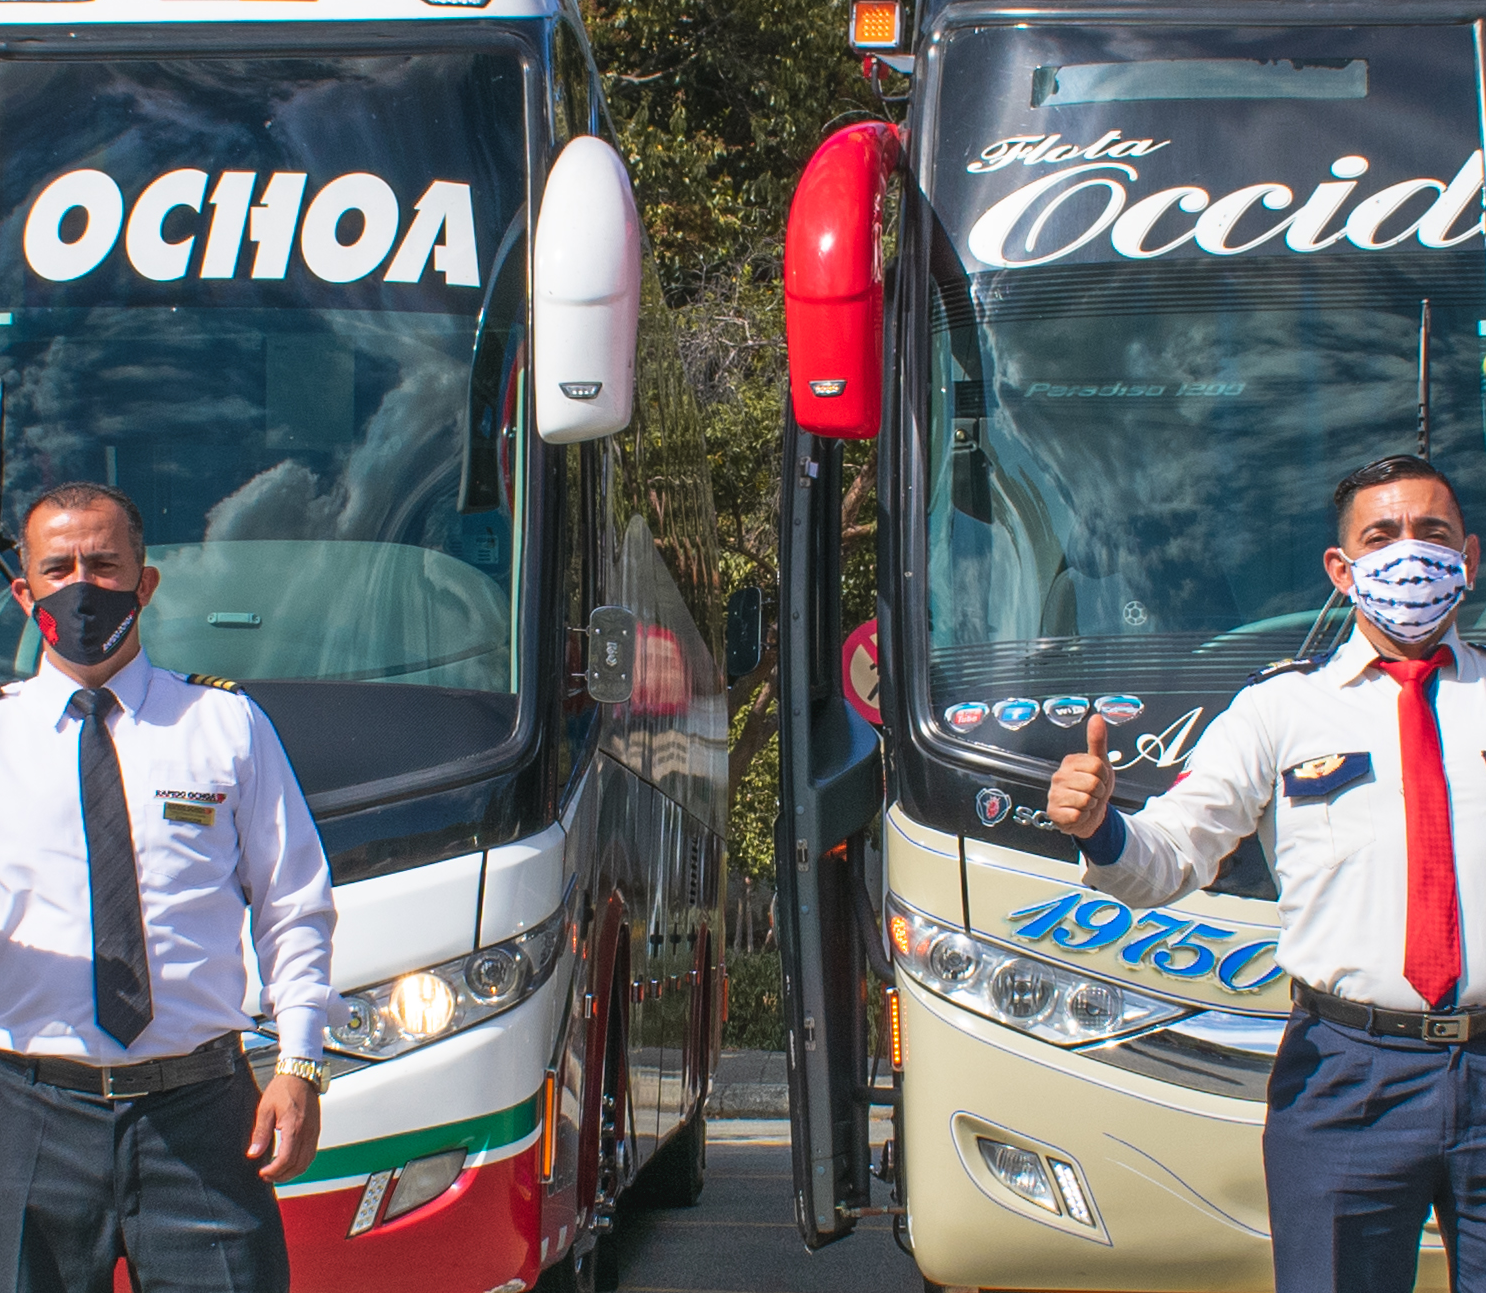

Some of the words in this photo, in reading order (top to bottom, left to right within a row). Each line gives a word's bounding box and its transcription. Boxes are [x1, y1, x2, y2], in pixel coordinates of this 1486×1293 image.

[967, 130, 1171, 173] Flota
[23, 168, 480, 287] OCHOA
[1007, 891, 1284, 993] 19750
